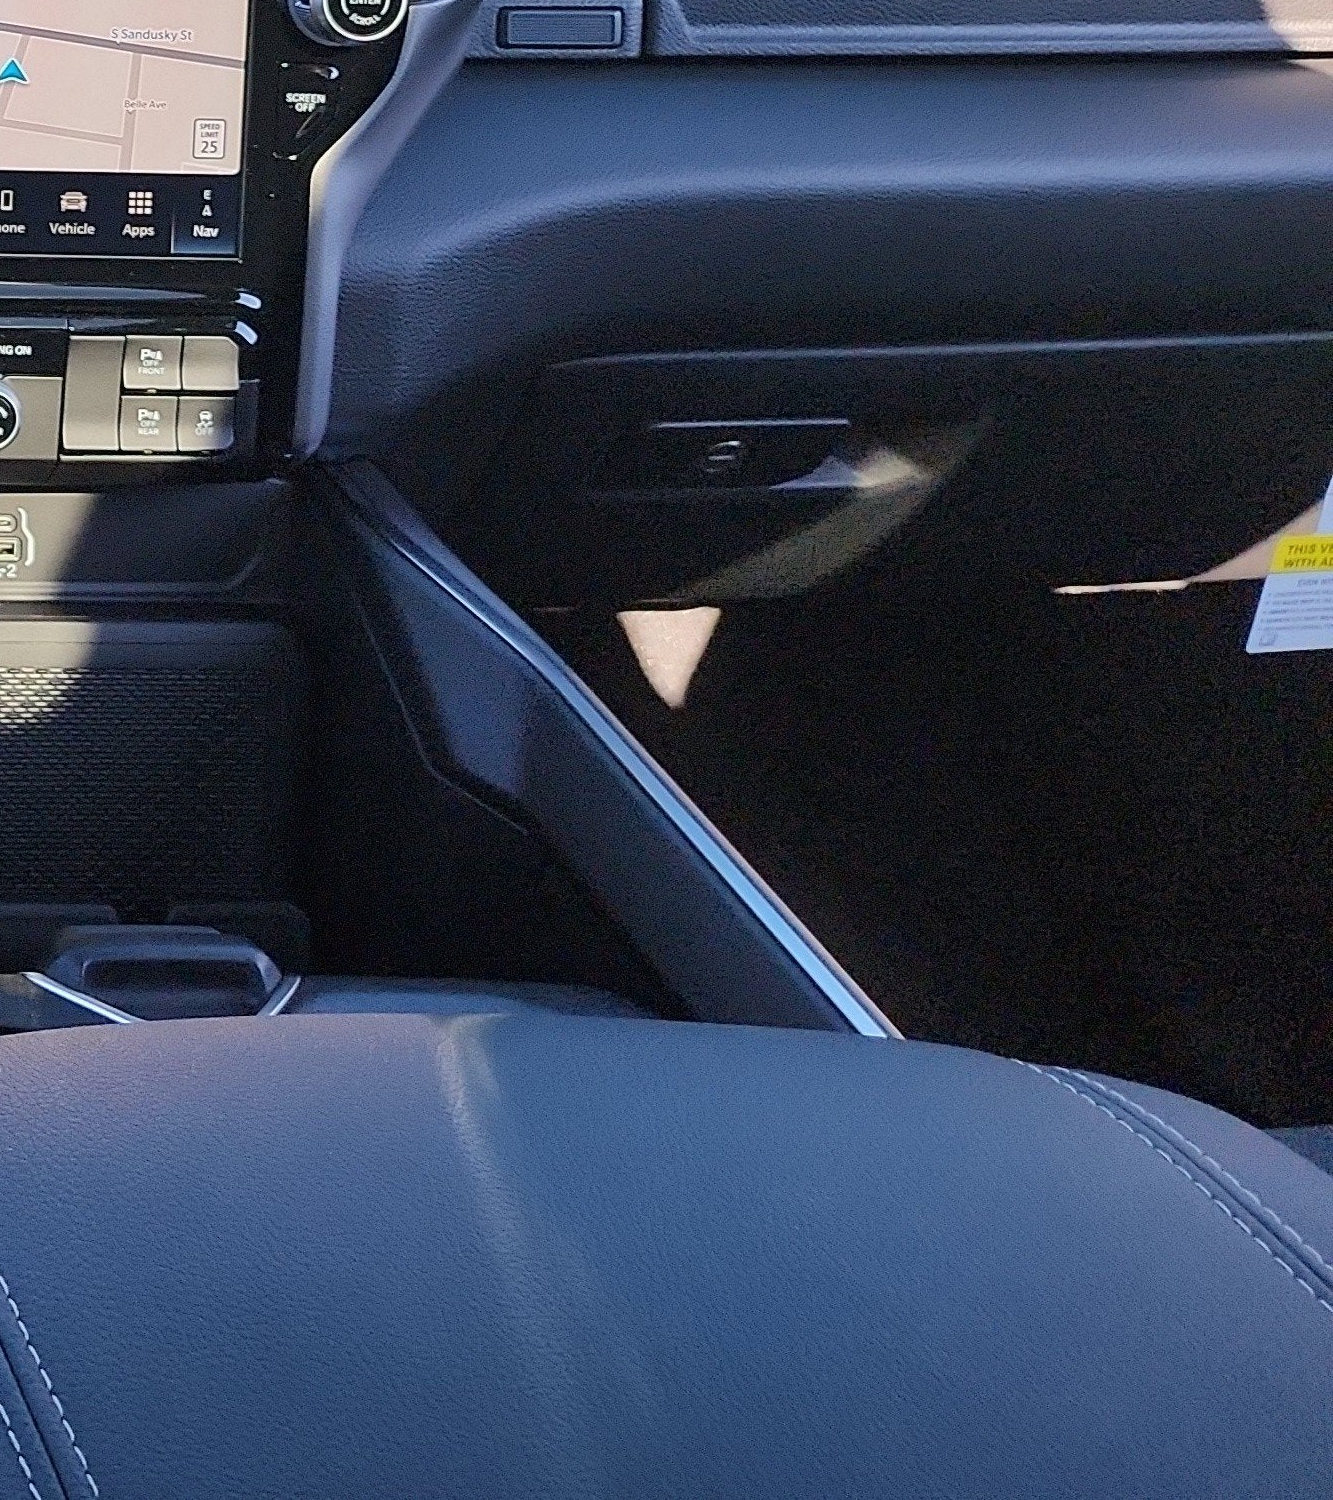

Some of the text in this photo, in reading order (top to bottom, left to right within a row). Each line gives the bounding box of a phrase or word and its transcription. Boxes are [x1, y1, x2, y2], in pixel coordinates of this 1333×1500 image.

[348, 12, 382, 26] SCROLL
[111, 28, 193, 42] S Sandusky St
[285, 92, 326, 103] SCREEN
[124, 100, 167, 109] Belle Ave
[295, 102, 315, 112] OFF
[199, 122, 221, 130] SPEED
[200, 130, 219, 138] LIMIT
[201, 140, 218, 154] 25
[49, 222, 95, 236] Vehicle
[122, 224, 155, 238] Apps
[193, 225, 220, 238] Nav
[15, 345, 32, 356] ON
[138, 367, 165, 376] FRONT
[140, 420, 157, 428] OFF
[138, 428, 160, 436] REAR
[195, 428, 214, 436] OFF
[1288, 544, 1316, 556] THIS
[1284, 557, 1317, 569] WITH
[7, 565, 18, 578] 2
